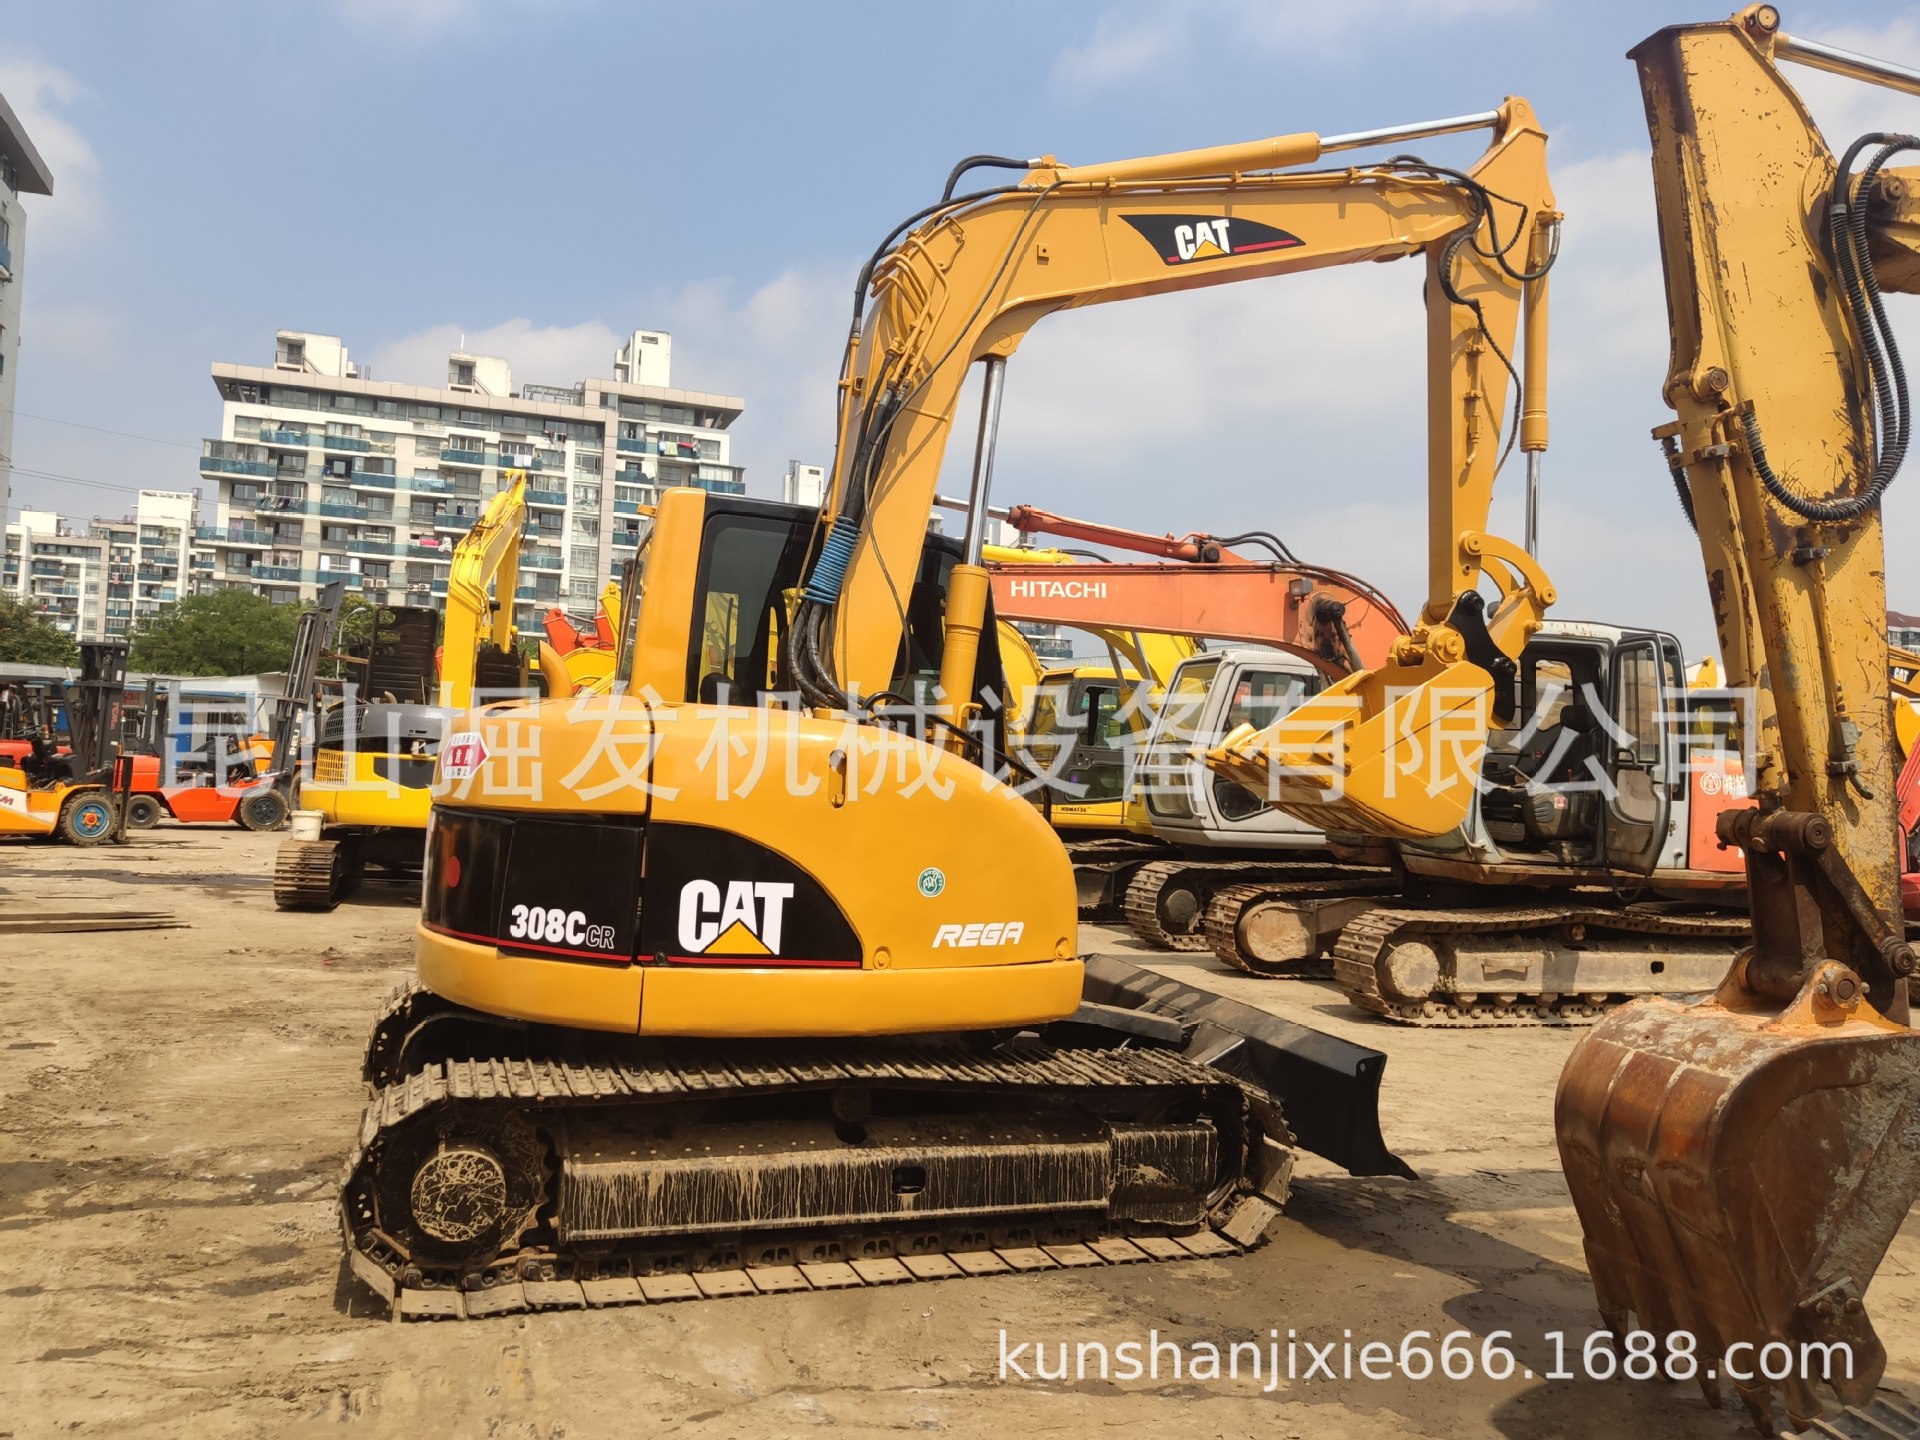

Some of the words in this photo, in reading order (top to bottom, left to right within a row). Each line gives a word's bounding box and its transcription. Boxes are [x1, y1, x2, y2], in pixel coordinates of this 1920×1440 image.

[1174, 218, 1231, 261] CAT
[1010, 580, 1107, 599] HITACHI
[1894, 666, 1910, 683] CAT
[1061, 805, 1087, 813] KOMATSU
[678, 879, 794, 955] CAT
[931, 921, 1024, 948] REGA
